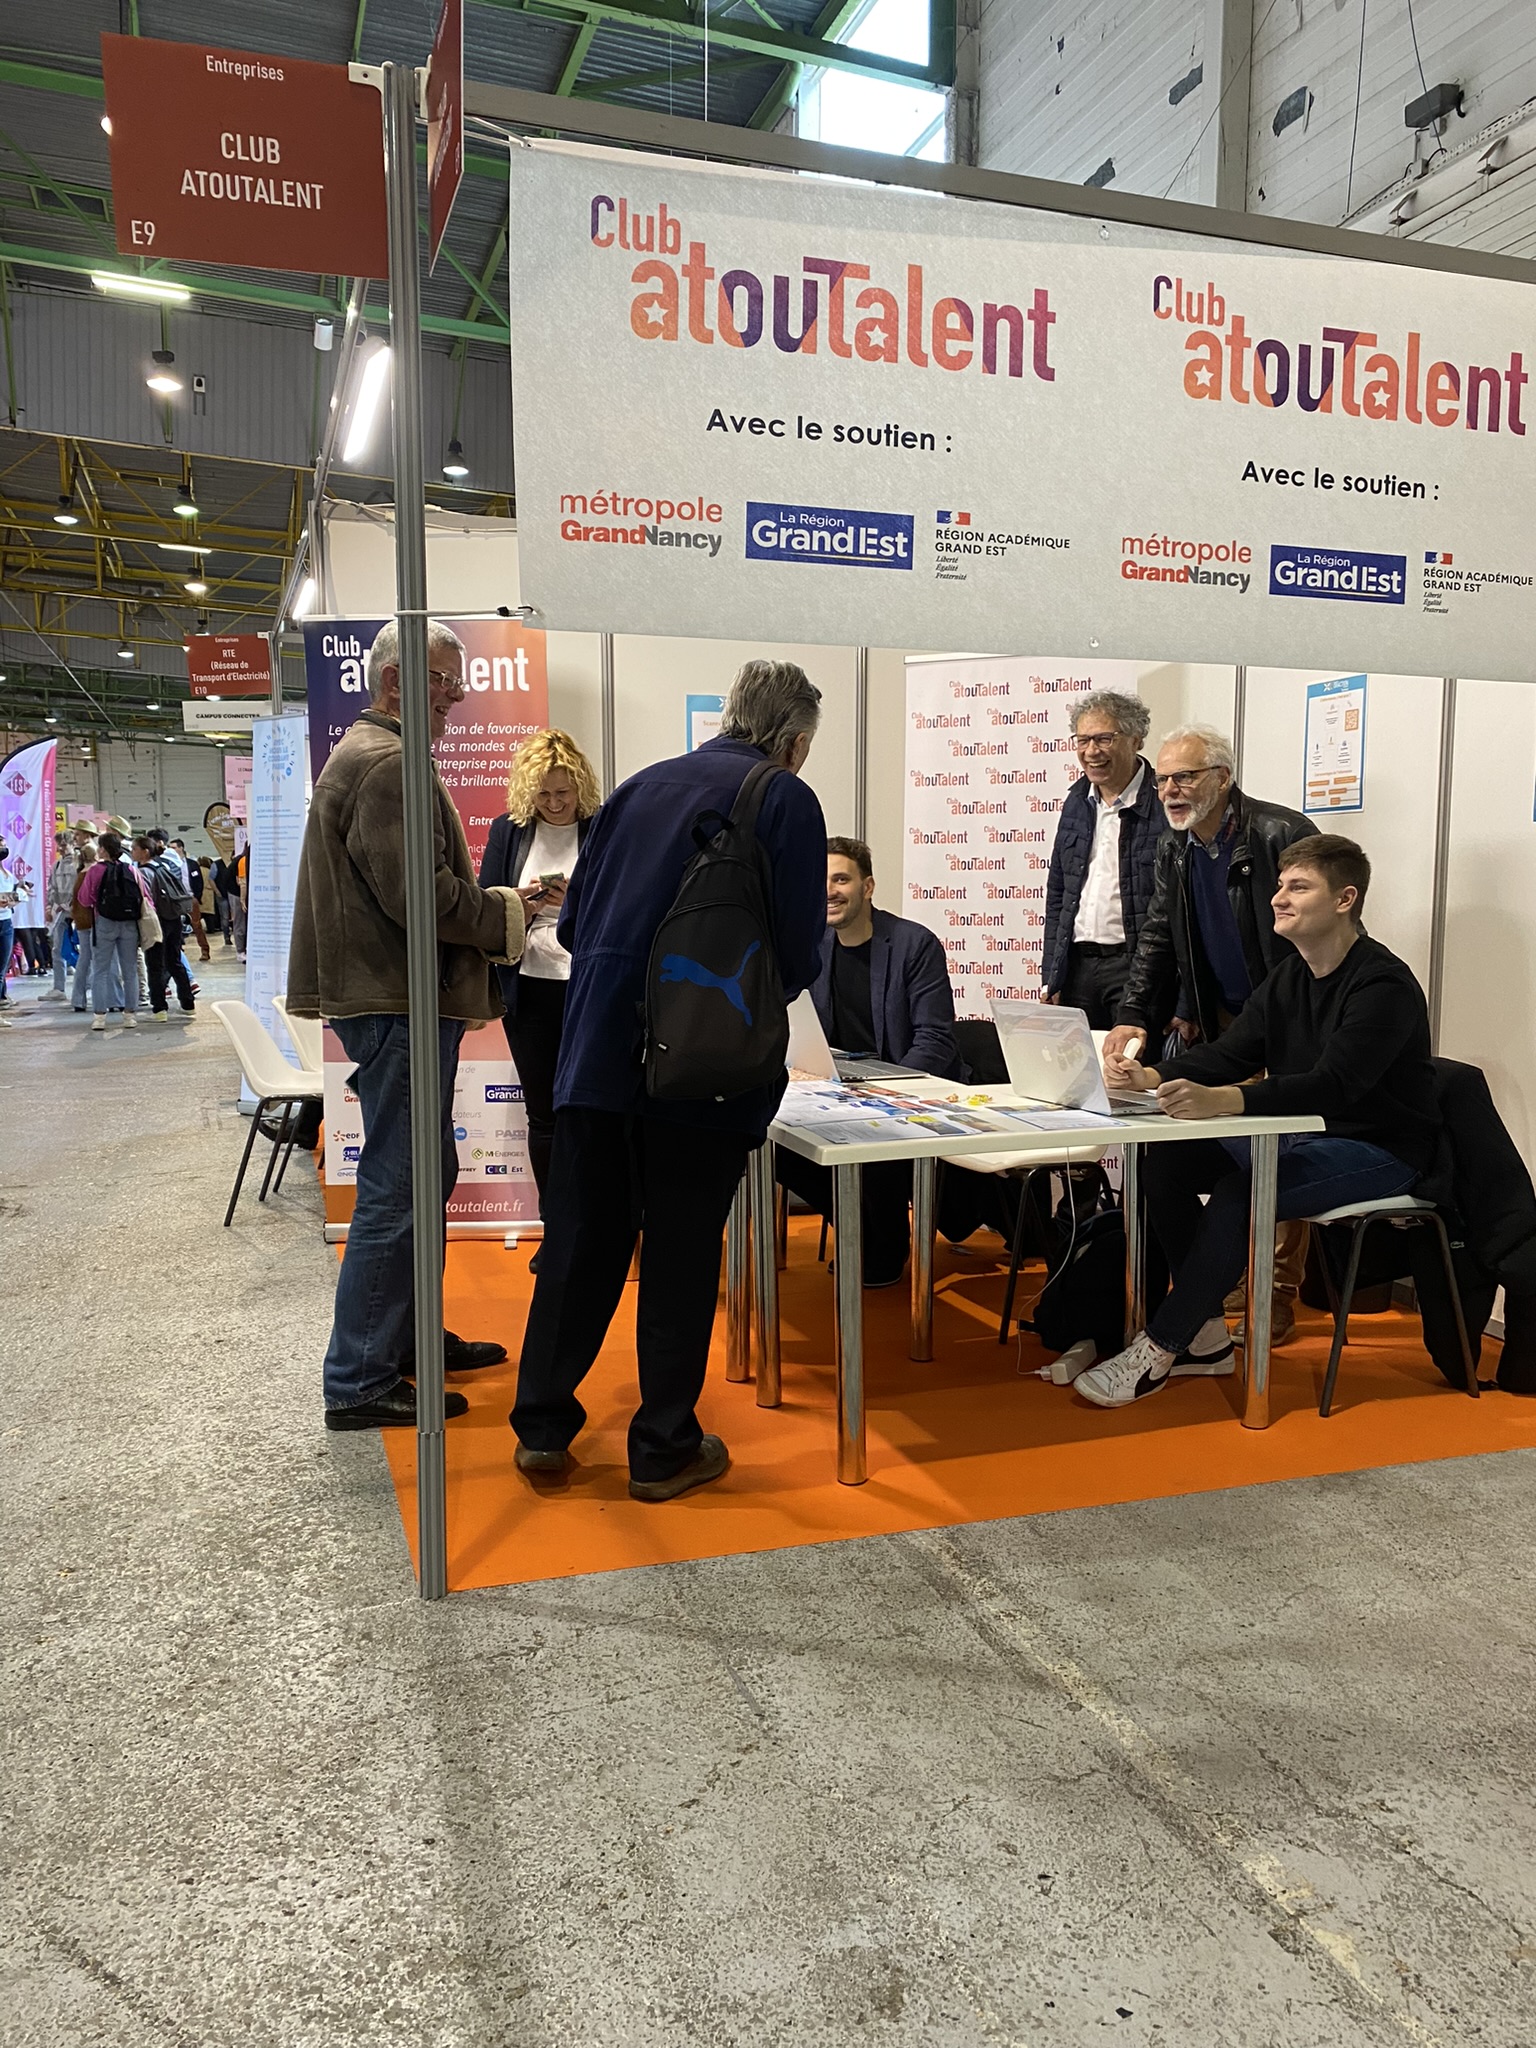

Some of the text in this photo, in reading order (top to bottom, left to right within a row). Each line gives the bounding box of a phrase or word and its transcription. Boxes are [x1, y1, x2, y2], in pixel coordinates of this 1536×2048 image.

[206, 55, 284, 82] Entreprises
[220, 132, 281, 164] CLUB
[180, 168, 324, 210] ATOUTALENT
[590, 194, 682, 255] Club
[131, 219, 156, 246] E9
[1153, 275, 1226, 327] Club
[630, 241, 1057, 382] atouTalent
[1183, 314, 1529, 436] atouTalent
[706, 408, 785, 439] Avec
[797, 416, 823, 441] le
[833, 420, 936, 452] soutien
[1241, 460, 1305, 487] Avec
[1314, 468, 1335, 489] le
[1342, 473, 1426, 499] soutien
[560, 489, 722, 524] métropole
[780, 511, 845, 528] La Région
[936, 528, 1070, 550] RÉGION ACADÉMIQUE
[935, 542, 1007, 556] GRAND EST
[1122, 533, 1252, 565] métropole
[936, 555, 959, 563] Liberté
[1297, 553, 1351, 567] La Région
[935, 563, 959, 572] Égalité
[935, 572, 967, 580] Fraternité
[1423, 567, 1533, 586] RÉGION ACADÉMIQUE
[1423, 580, 1481, 592] GRAND EST
[222, 649, 236, 658] RTE
[322, 635, 360, 657] Club
[211, 661, 249, 670] (Réseau de
[192, 673, 226, 683] Transport
[1033, 677, 1092, 694] atouTalent
[195, 686, 208, 695] E10
[954, 682, 1010, 698] atouTalent
[915, 713, 971, 729] atouTalent
[991, 709, 1049, 726] atouTalent
[328, 724, 344, 736] Le
[469, 722, 485, 735] de
[487, 722, 538, 735] favoriser
[439, 740, 523, 752] les mondes de
[952, 741, 1009, 757] atouTalent
[1032, 738, 1077, 753] atouTale
[437, 757, 513, 771] ntreprise pou
[460, 774, 510, 786] brillante
[914, 772, 969, 787] atouTalent
[990, 769, 1047, 785] atouTalent
[951, 800, 1007, 816] atouTalent
[1030, 798, 1064, 813] atouTa
[468, 816, 494, 826] Entre
[913, 830, 968, 844] atouTalent
[988, 828, 1046, 843] atouTalent
[950, 857, 1006, 871] atouTalent
[912, 886, 967, 900] atouTalent
[987, 885, 1044, 899] atouTalent
[949, 912, 1004, 927] atouTalent
[986, 937, 1042, 951] atouTalent
[949, 961, 1003, 975] atouTalent
[985, 985, 1042, 1000] atouTalent
[446, 1199, 525, 1214] toutalent.fr
